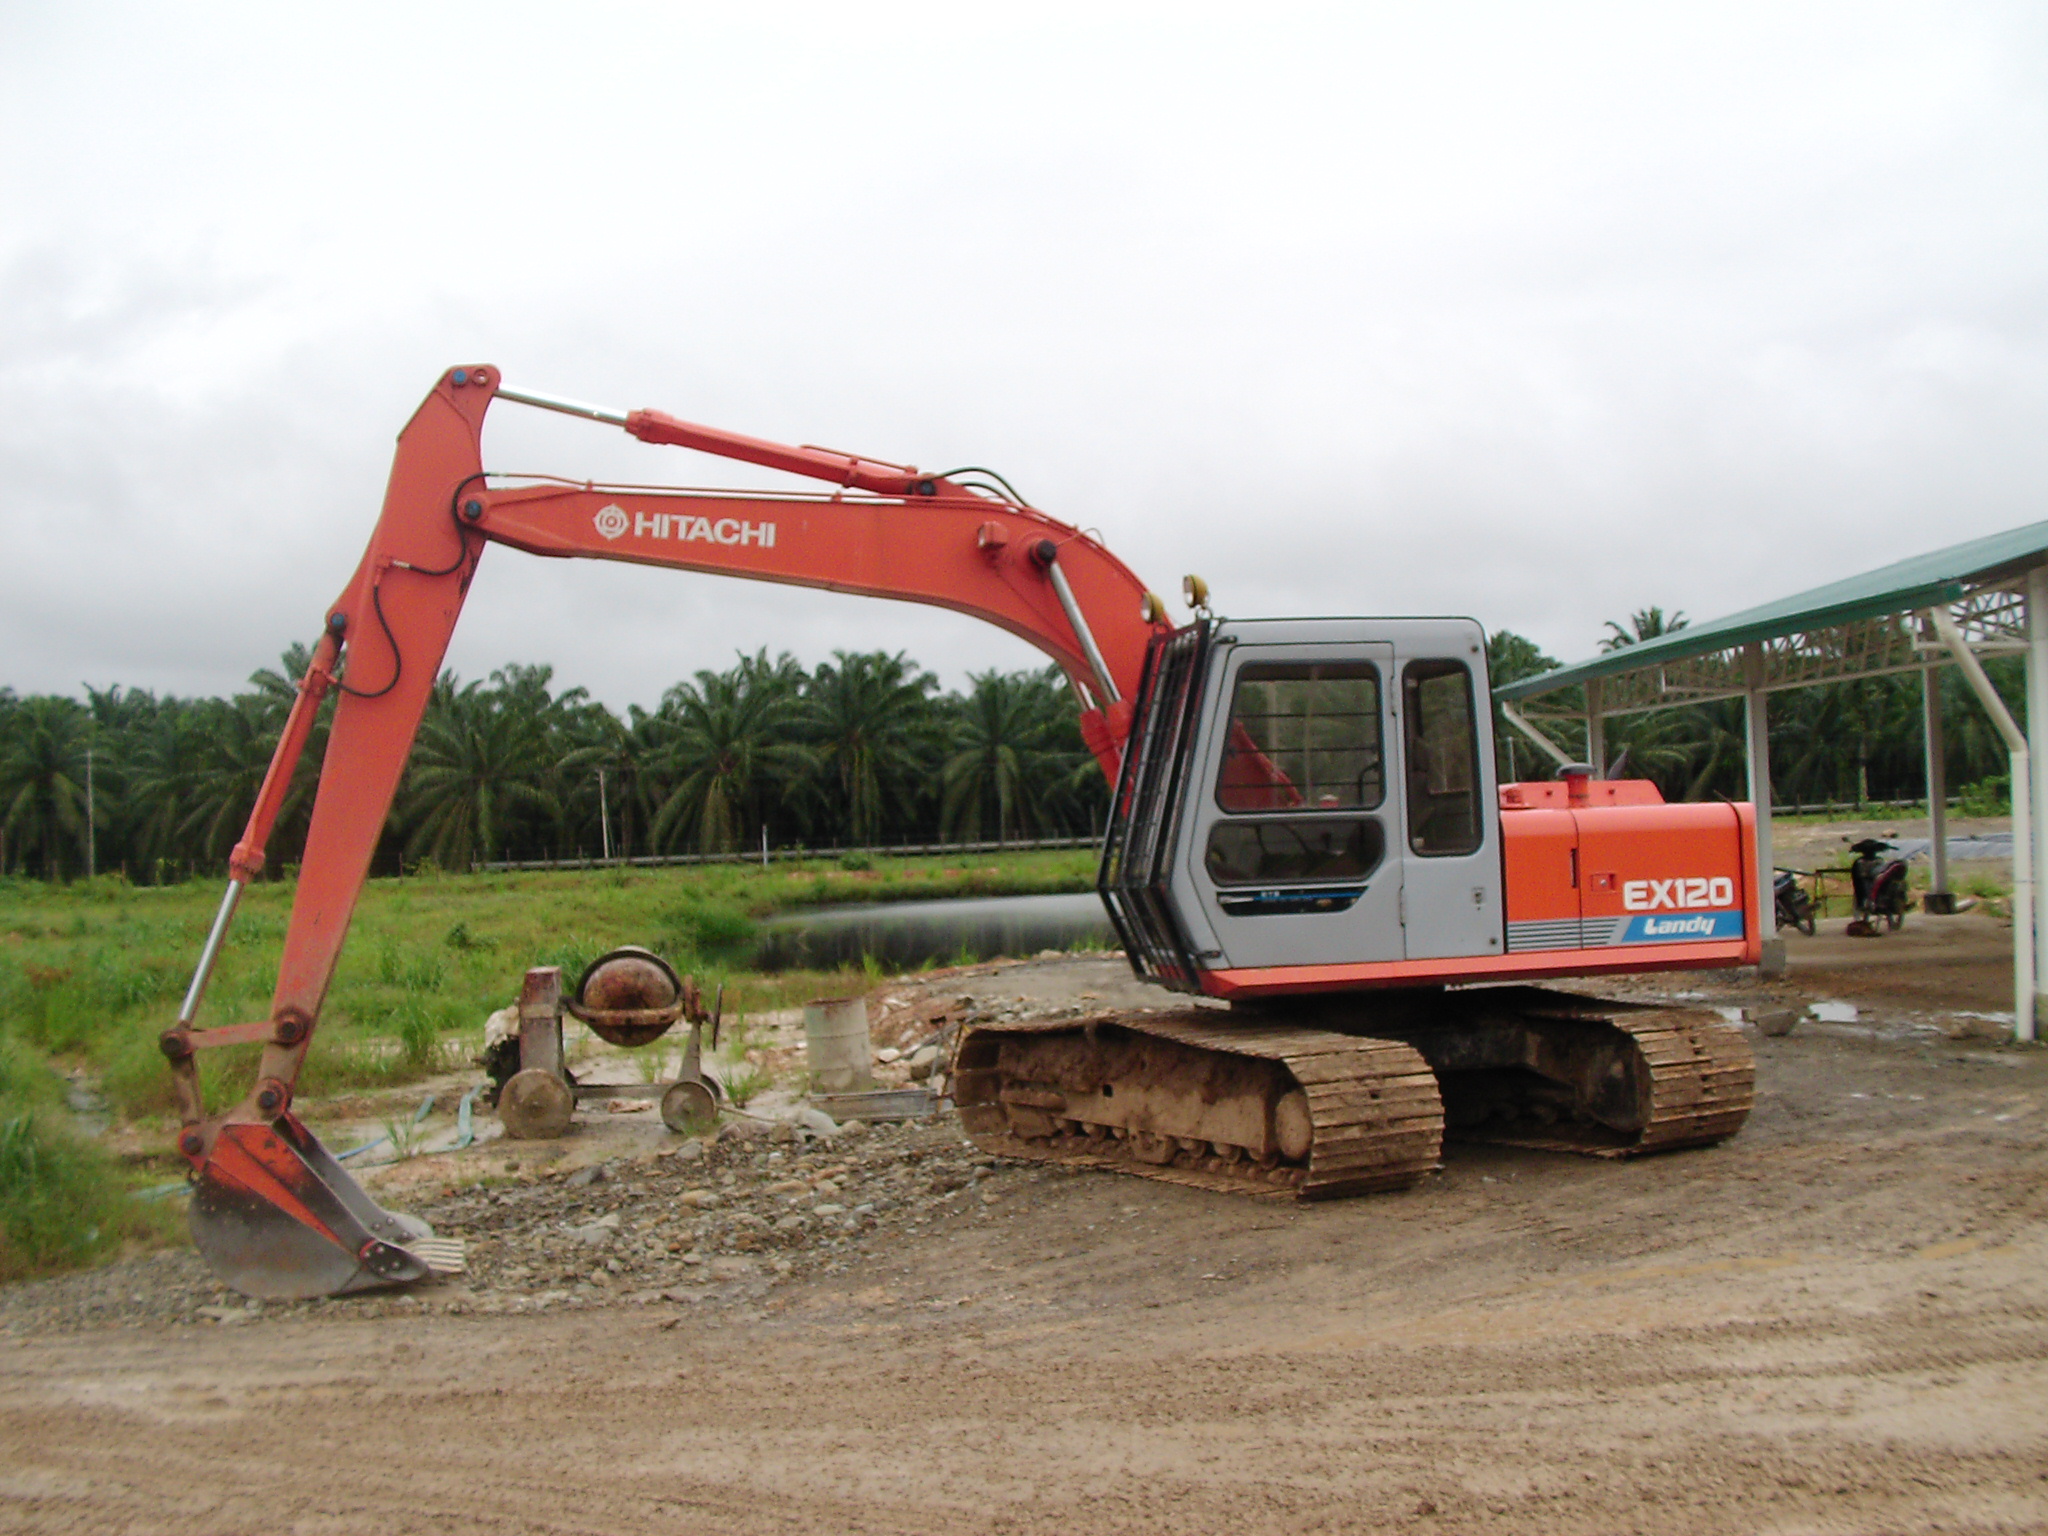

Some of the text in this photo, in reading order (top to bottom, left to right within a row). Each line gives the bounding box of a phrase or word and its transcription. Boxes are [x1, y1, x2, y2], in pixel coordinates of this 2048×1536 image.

[635, 511, 776, 547] HITACHI
[1623, 877, 1733, 910] EX120
[1644, 916, 1716, 936] Landy
